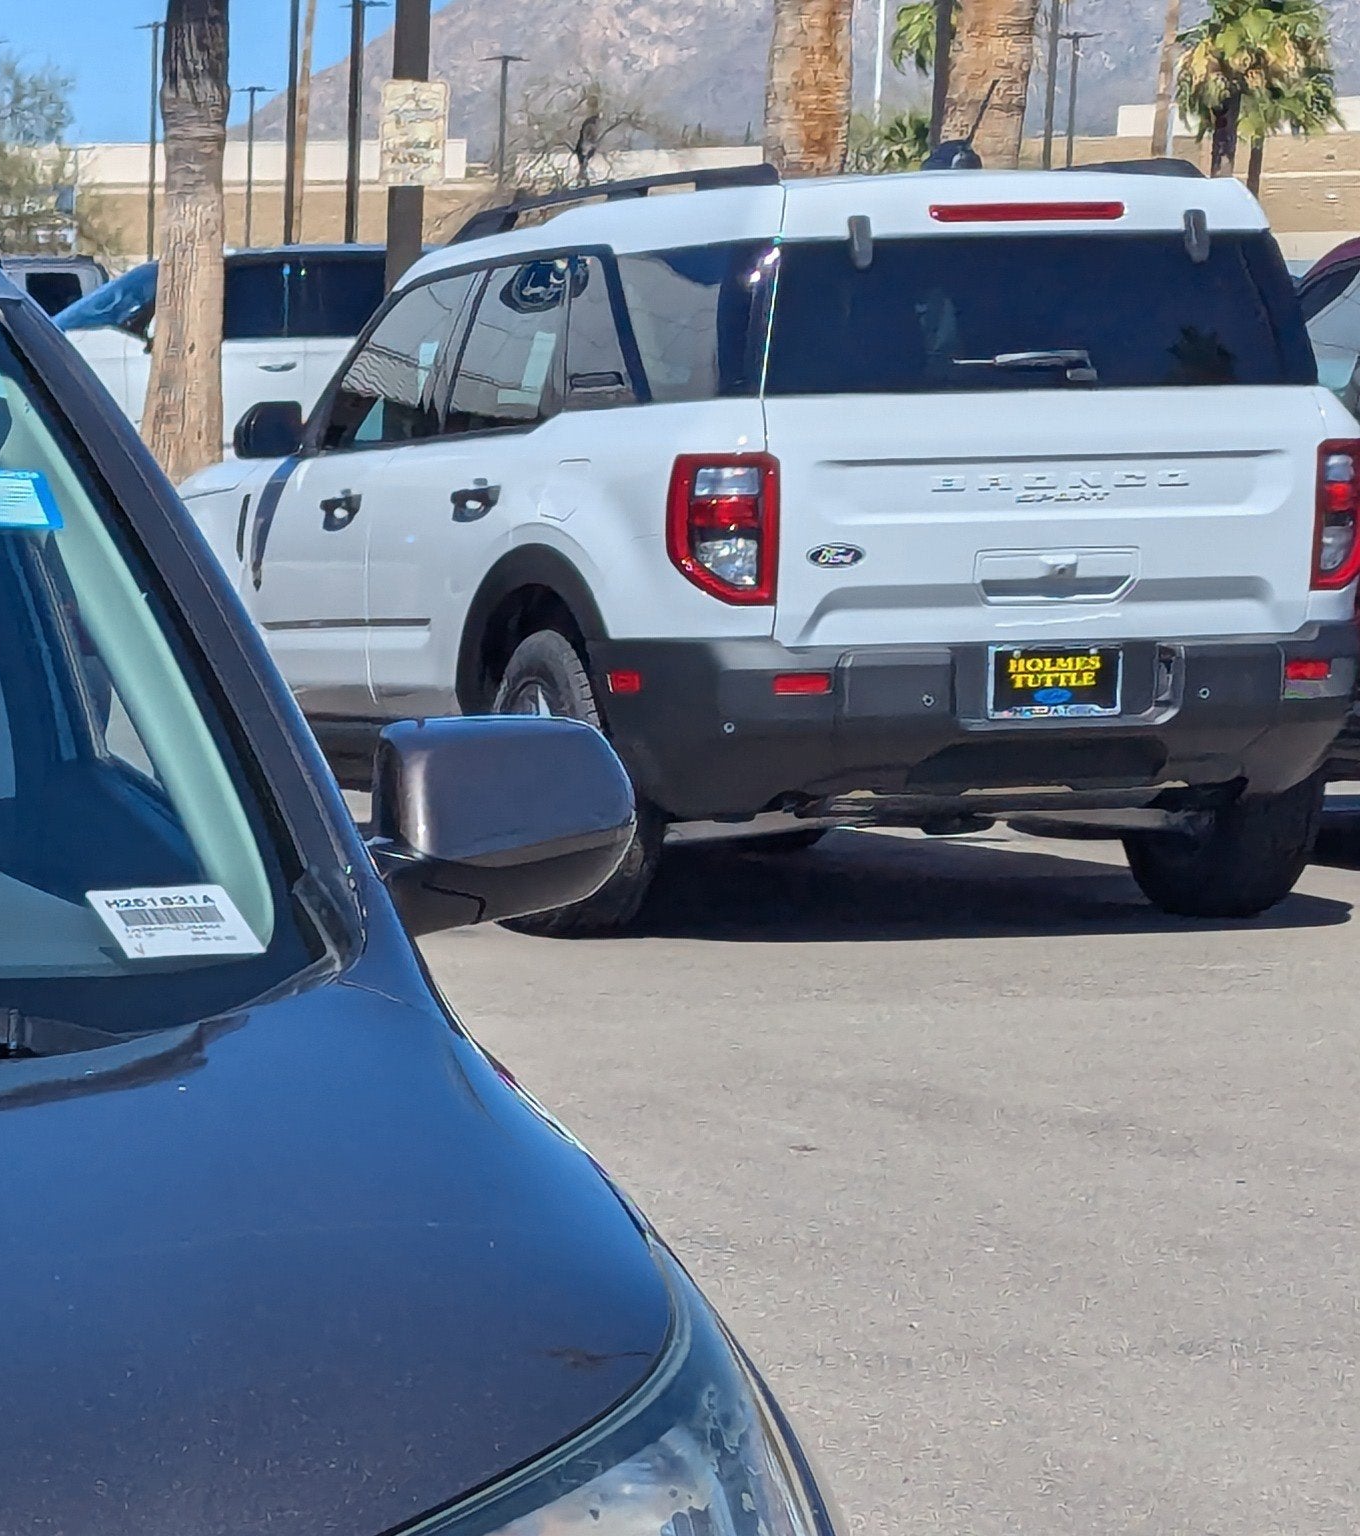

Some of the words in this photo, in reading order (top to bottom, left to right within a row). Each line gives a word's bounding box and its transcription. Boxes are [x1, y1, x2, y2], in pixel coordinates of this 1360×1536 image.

[931, 471, 1190, 492] BRONCO
[1008, 656, 1101, 673] HOLMES
[1010, 671, 1096, 689] TUTTLE
